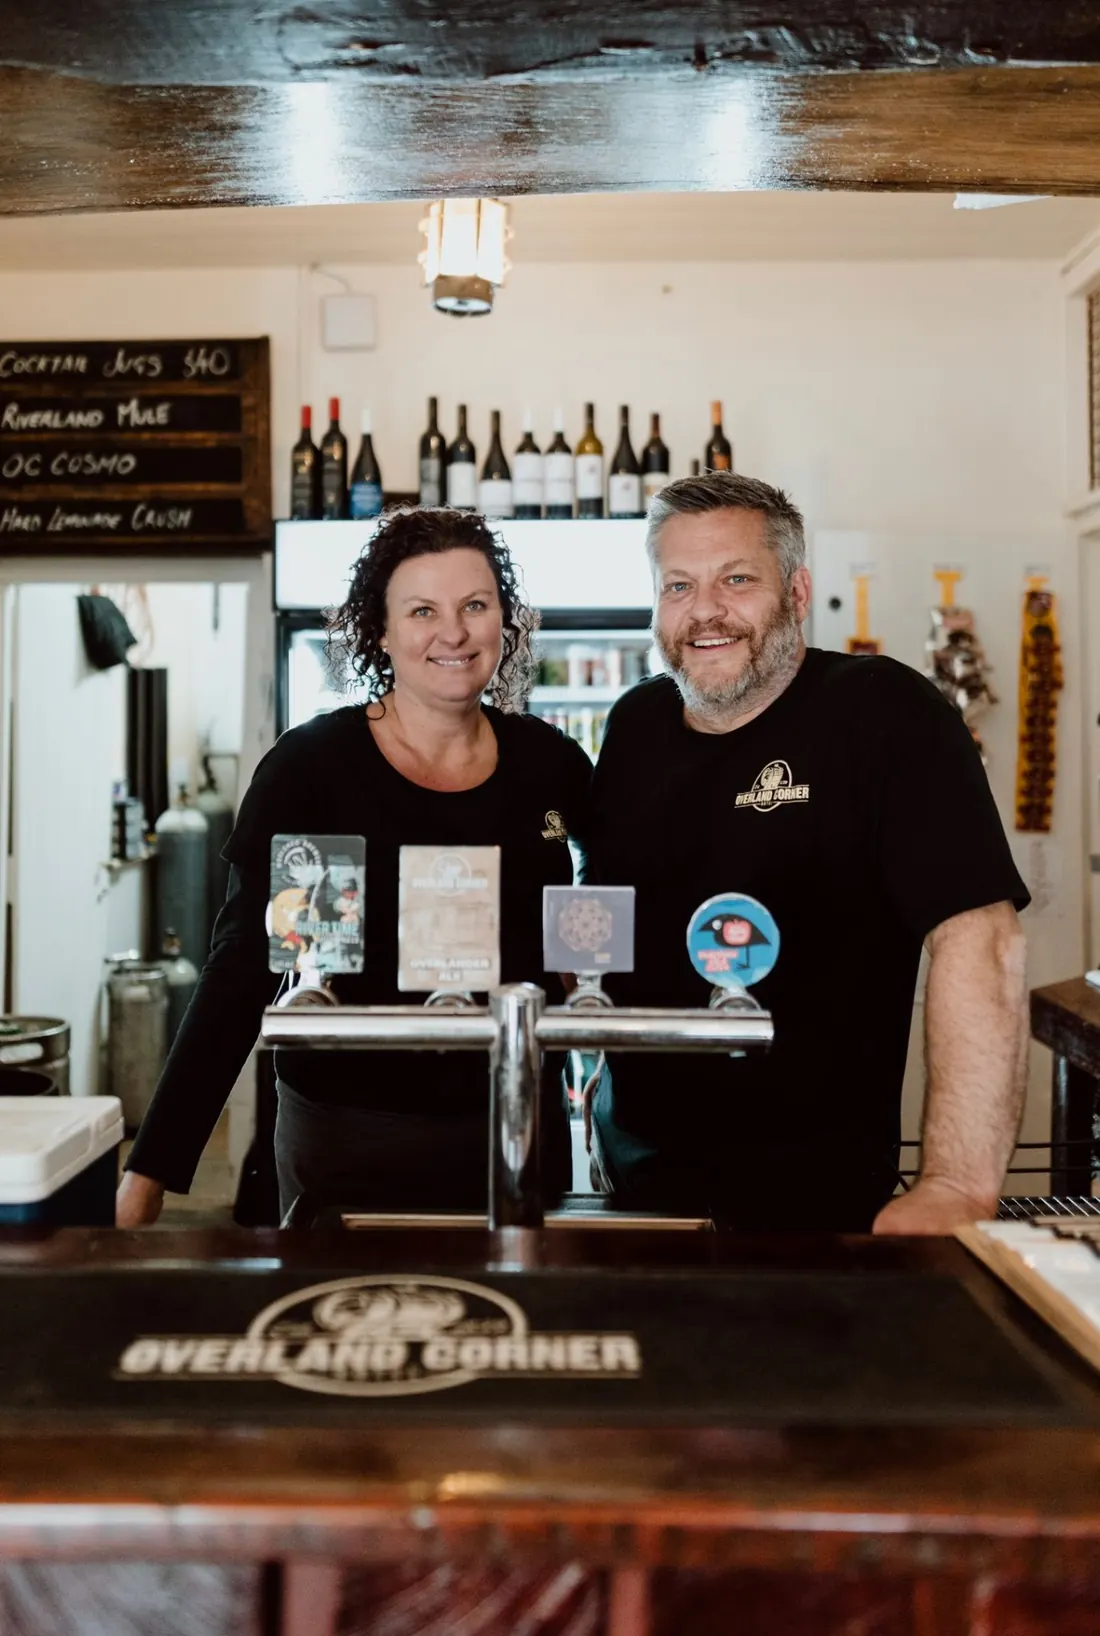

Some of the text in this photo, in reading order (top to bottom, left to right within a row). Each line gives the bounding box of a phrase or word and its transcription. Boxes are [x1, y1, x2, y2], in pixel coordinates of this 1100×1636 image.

[183, 347, 230, 379] $40
[1, 396, 172, 430] RIVERLAND MULE
[2, 452, 137, 478] OC COSMO
[132, 502, 193, 530] CRUSH
[735, 787, 810, 806] OVERLAND CORNER
[119, 1337, 407, 1375] OVERLAND
[422, 1334, 641, 1373] CORNER
